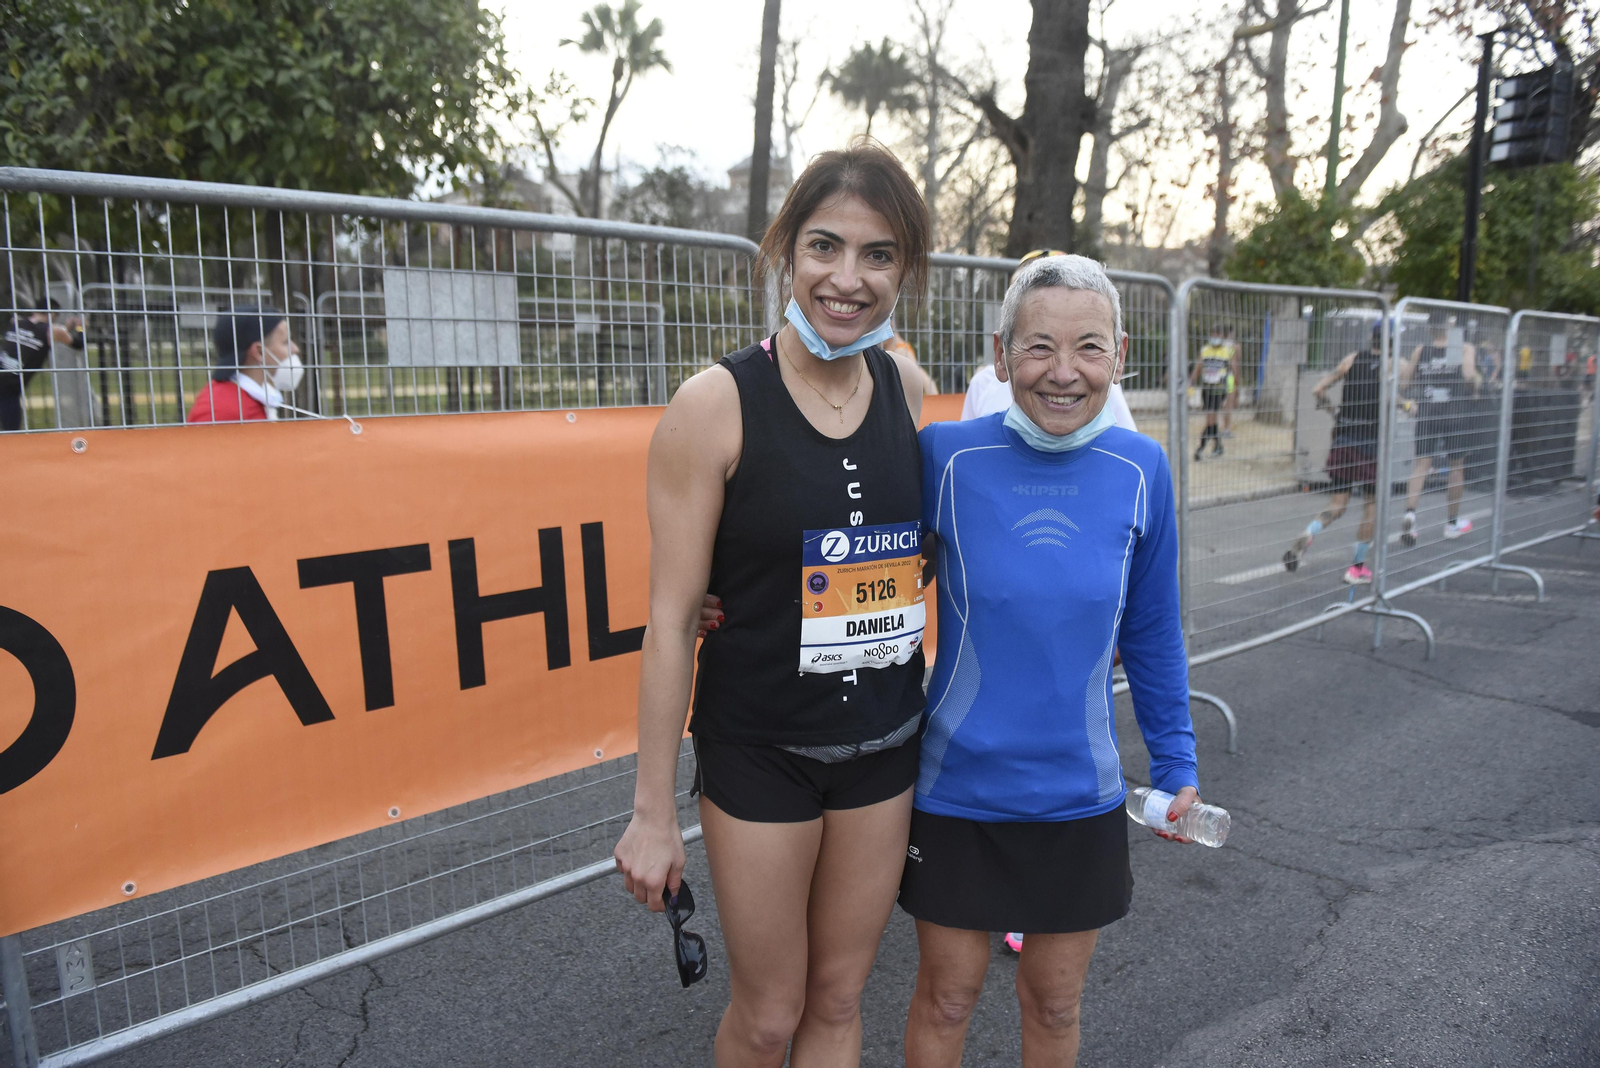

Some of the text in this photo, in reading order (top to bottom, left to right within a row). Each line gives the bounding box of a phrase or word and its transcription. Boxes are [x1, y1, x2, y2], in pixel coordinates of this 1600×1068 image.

[842, 458, 863, 528] JUS
[854, 530, 918, 555] ZURICH
[856, 578, 897, 604] 5126
[846, 613, 905, 637] DANIELA
